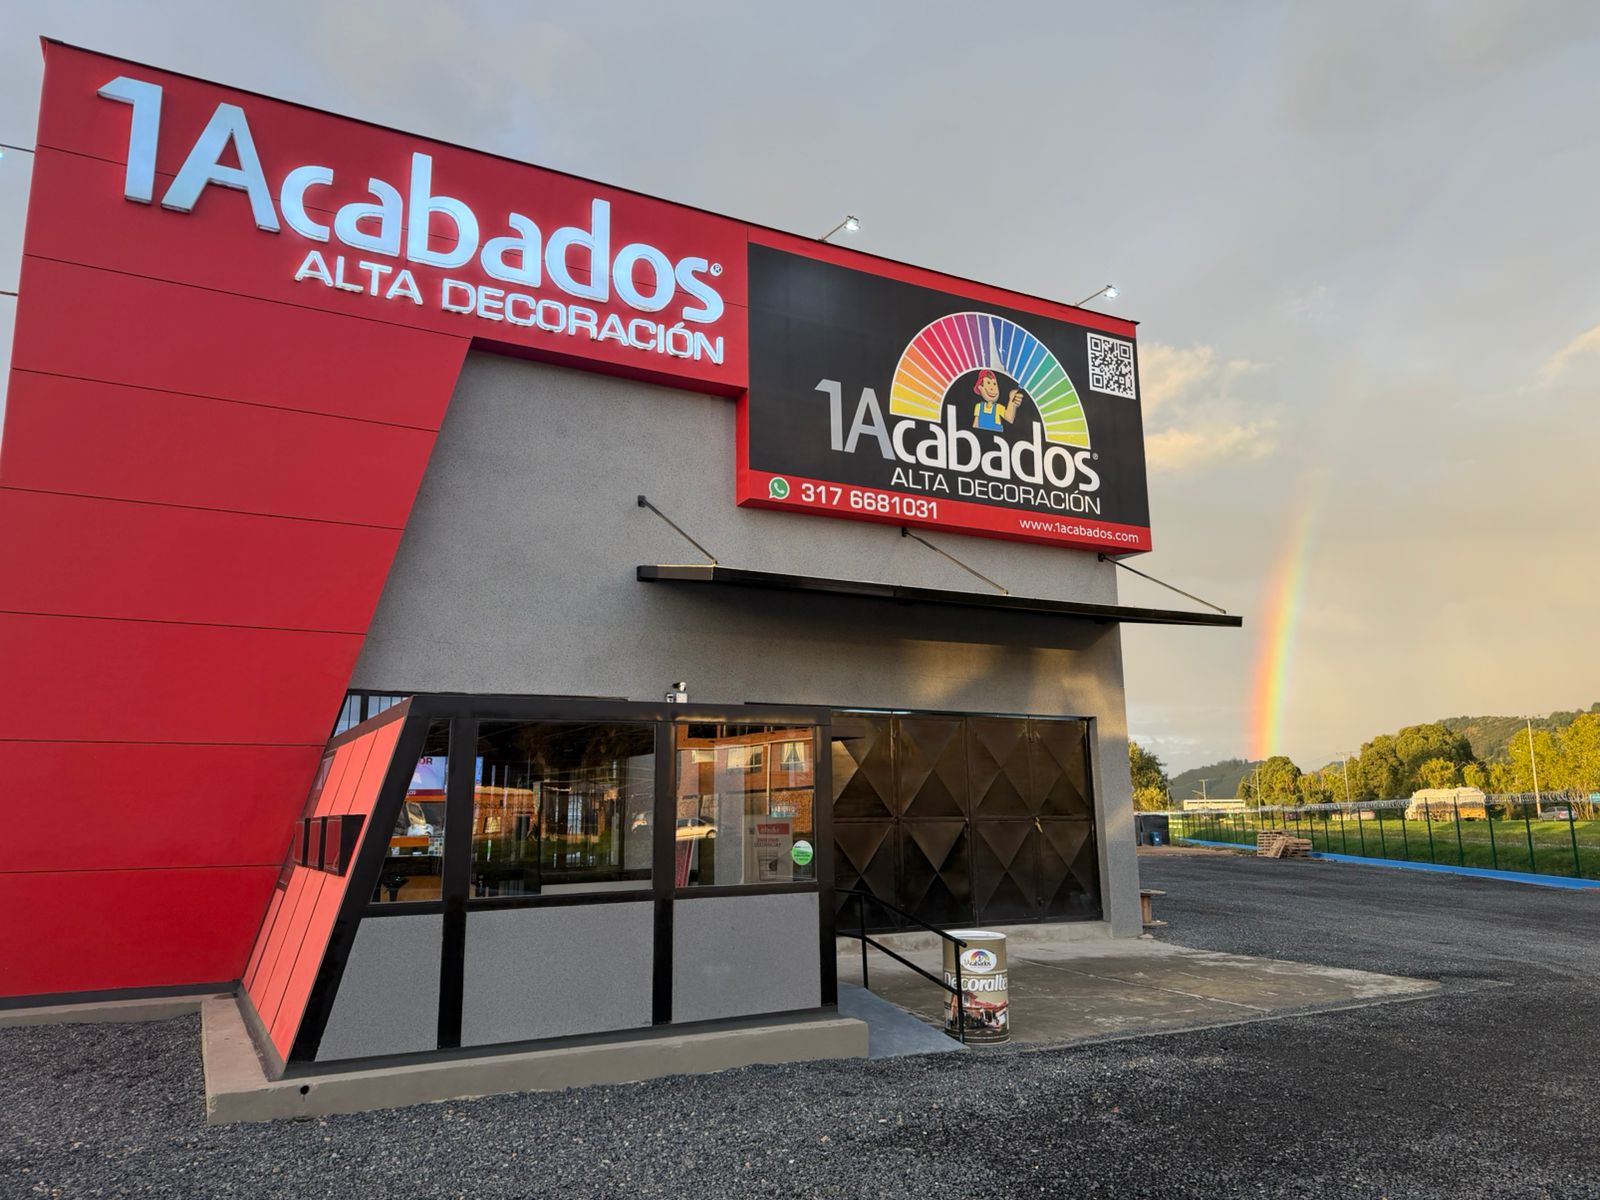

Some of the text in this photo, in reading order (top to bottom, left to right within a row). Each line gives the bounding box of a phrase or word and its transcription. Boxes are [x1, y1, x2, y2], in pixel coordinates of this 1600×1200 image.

[293, 250, 725, 365] ALTA DECORACIÓN
[801, 482, 938, 520] 317 6681031
[890, 467, 1101, 515] ALTA DECORACIÓN
[1019, 519, 1140, 543] www.1acabados.com
